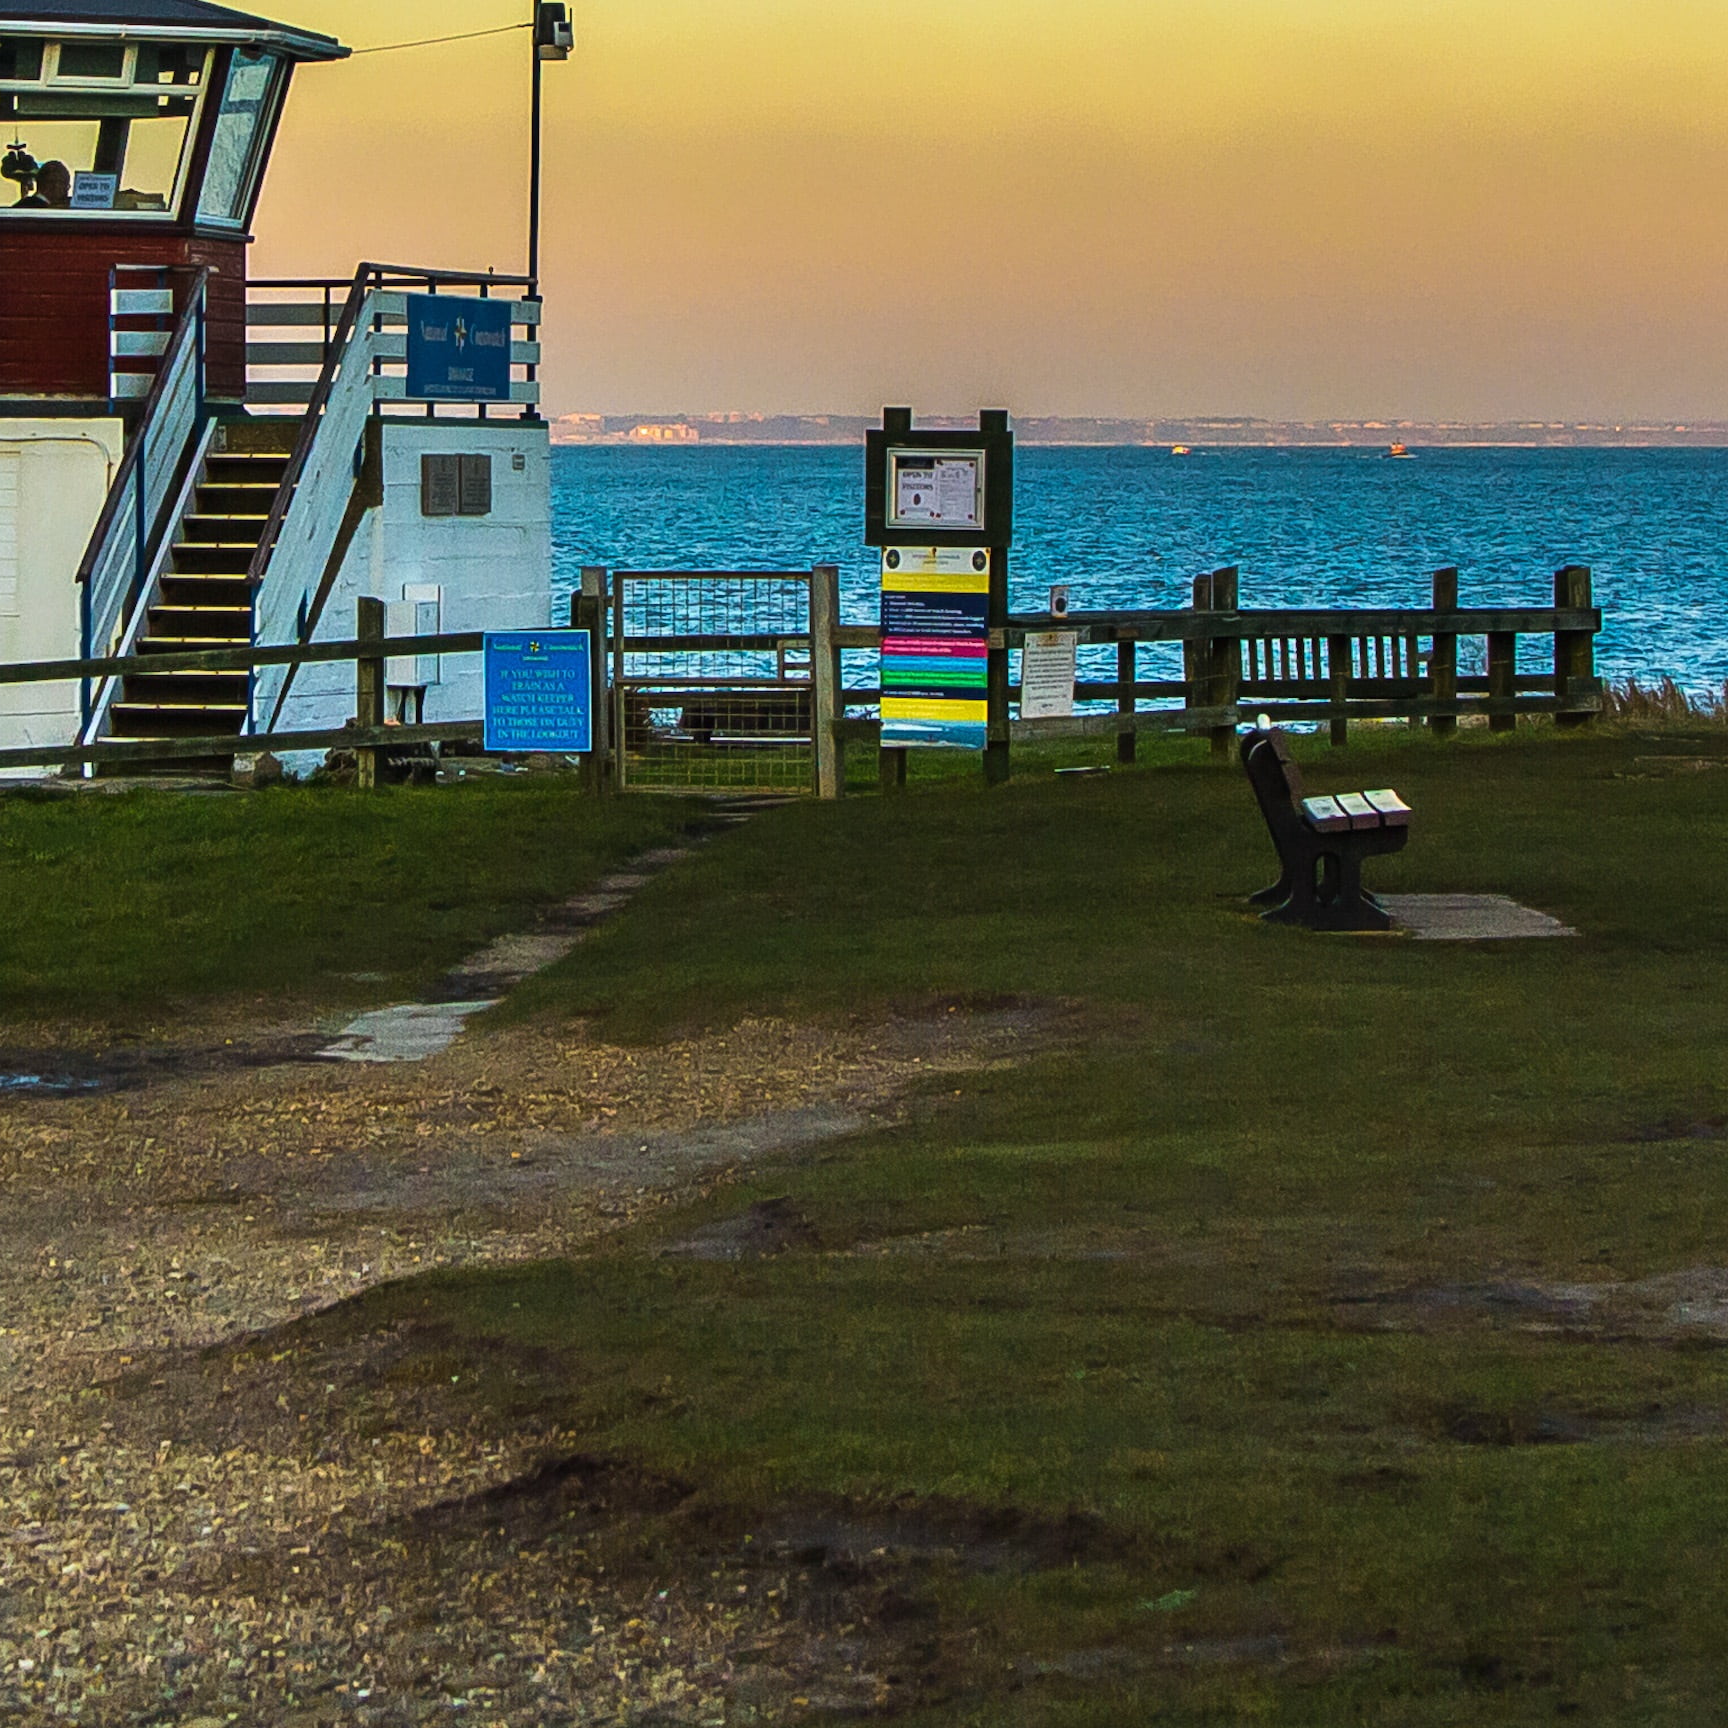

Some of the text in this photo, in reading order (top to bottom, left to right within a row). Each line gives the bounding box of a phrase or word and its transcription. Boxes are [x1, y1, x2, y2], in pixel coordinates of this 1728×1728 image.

[511, 669, 533, 679] YOU
[534, 669, 560, 679] WISH
[561, 669, 575, 680] TO
[557, 682, 565, 691] A
[492, 705, 584, 715] HERE PLEASE TALK
[493, 716, 506, 727] TO
[508, 716, 537, 727] THOSE
[540, 716, 555, 727] ON
[497, 729, 578, 740] IN THE LOOKOUT
